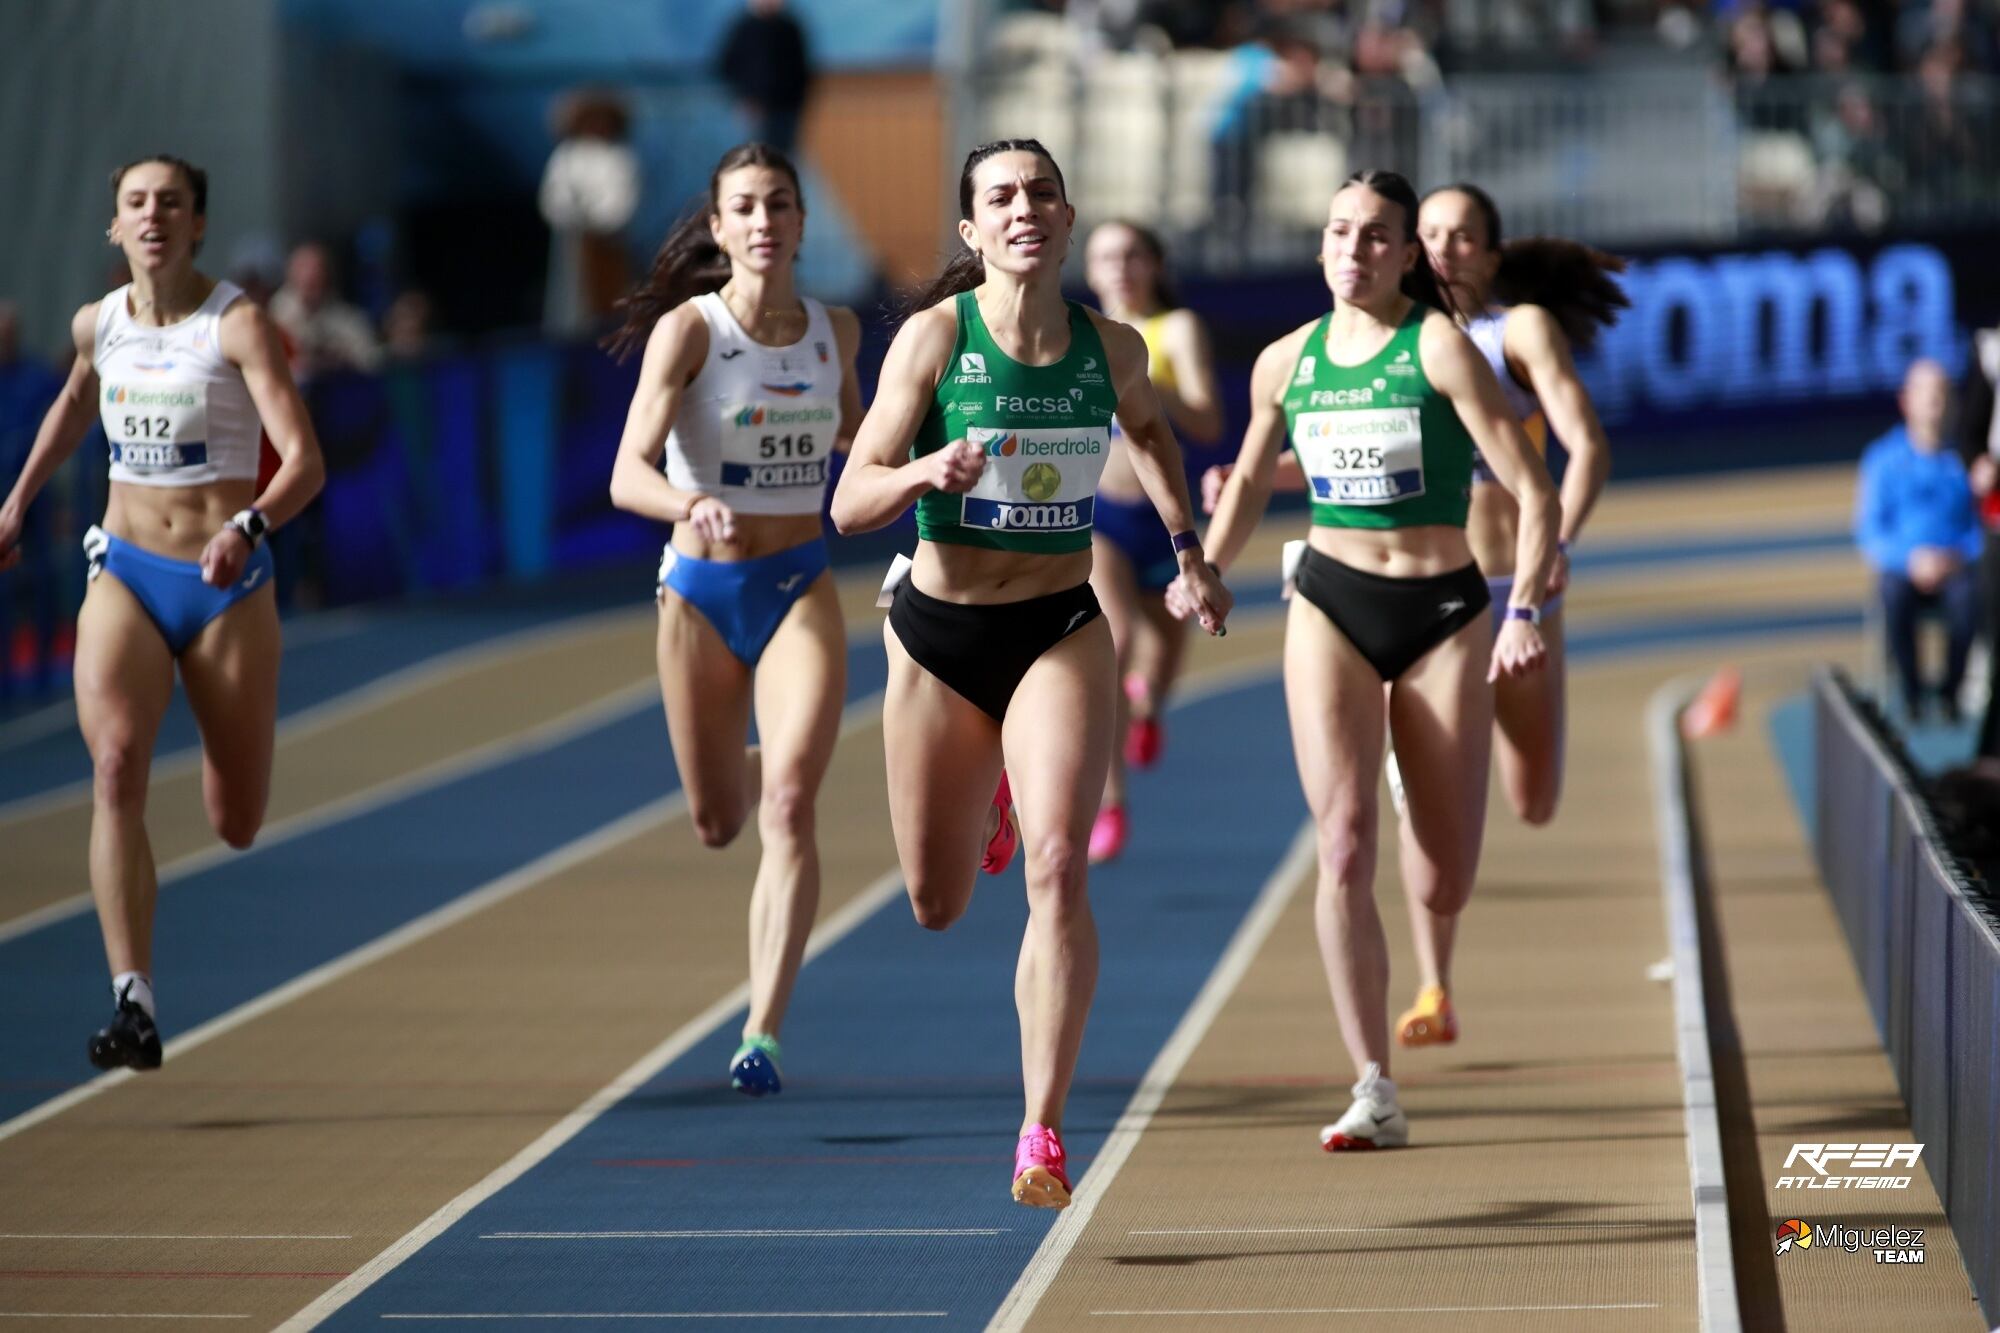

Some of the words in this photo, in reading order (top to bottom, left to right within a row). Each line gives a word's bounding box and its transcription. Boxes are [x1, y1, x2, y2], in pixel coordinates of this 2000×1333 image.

[954, 373, 992, 384] rasán
[129, 390, 195, 406] Iberdrola
[995, 395, 1074, 413] Facsa
[767, 408, 833, 425] Iberdrola
[124, 416, 170, 438] 512
[760, 434, 814, 458] 516
[1021, 437, 1101, 456] Iberdrola
[1332, 447, 1384, 470] 325
[744, 464, 823, 487] Joma
[991, 503, 1079, 529] Joma
